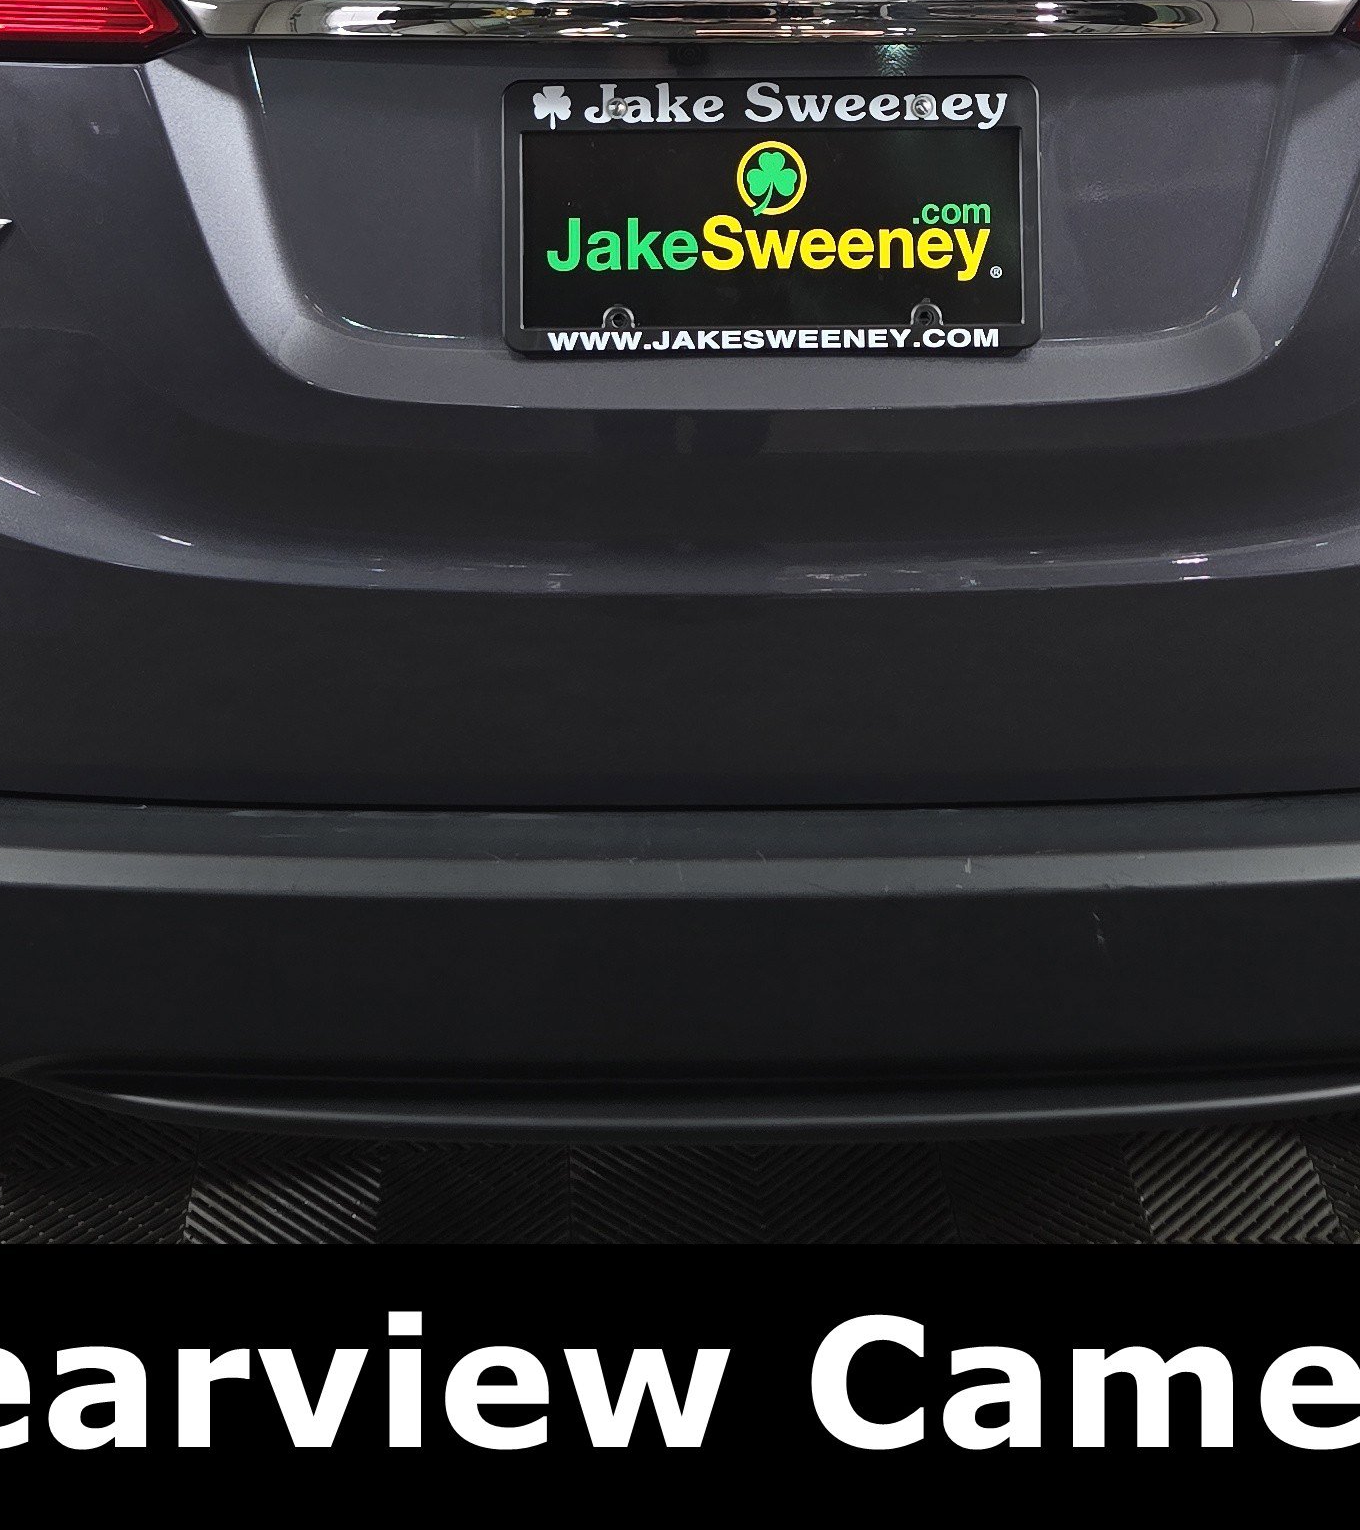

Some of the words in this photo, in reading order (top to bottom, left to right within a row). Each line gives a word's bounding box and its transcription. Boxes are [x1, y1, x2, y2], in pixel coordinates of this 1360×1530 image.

[583, 82, 725, 124] Jake
[744, 81, 1008, 130] Sweeney
[912, 201, 991, 225] .com
[547, 215, 991, 282] JakeSweeney
[547, 328, 1000, 351] WWW.JAKESWEENEY.COM
